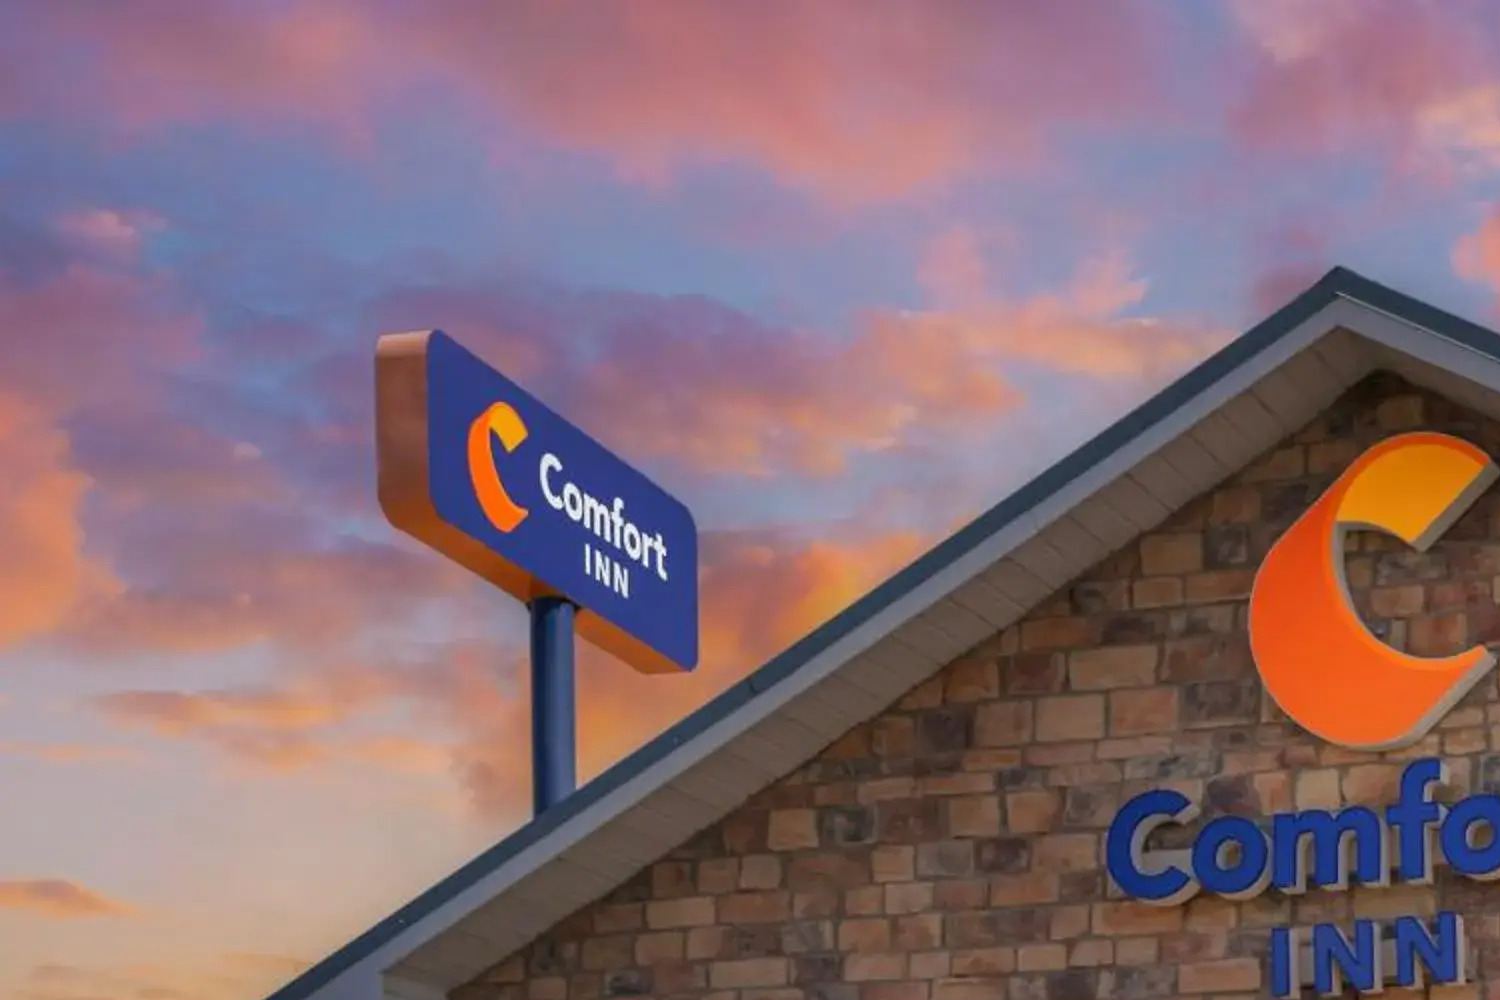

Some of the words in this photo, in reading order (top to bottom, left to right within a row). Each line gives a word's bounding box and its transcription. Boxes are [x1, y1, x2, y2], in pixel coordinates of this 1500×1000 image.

[539, 453, 667, 582] Comfort
[584, 543, 629, 599] INN
[1270, 910, 1465, 998] INN
